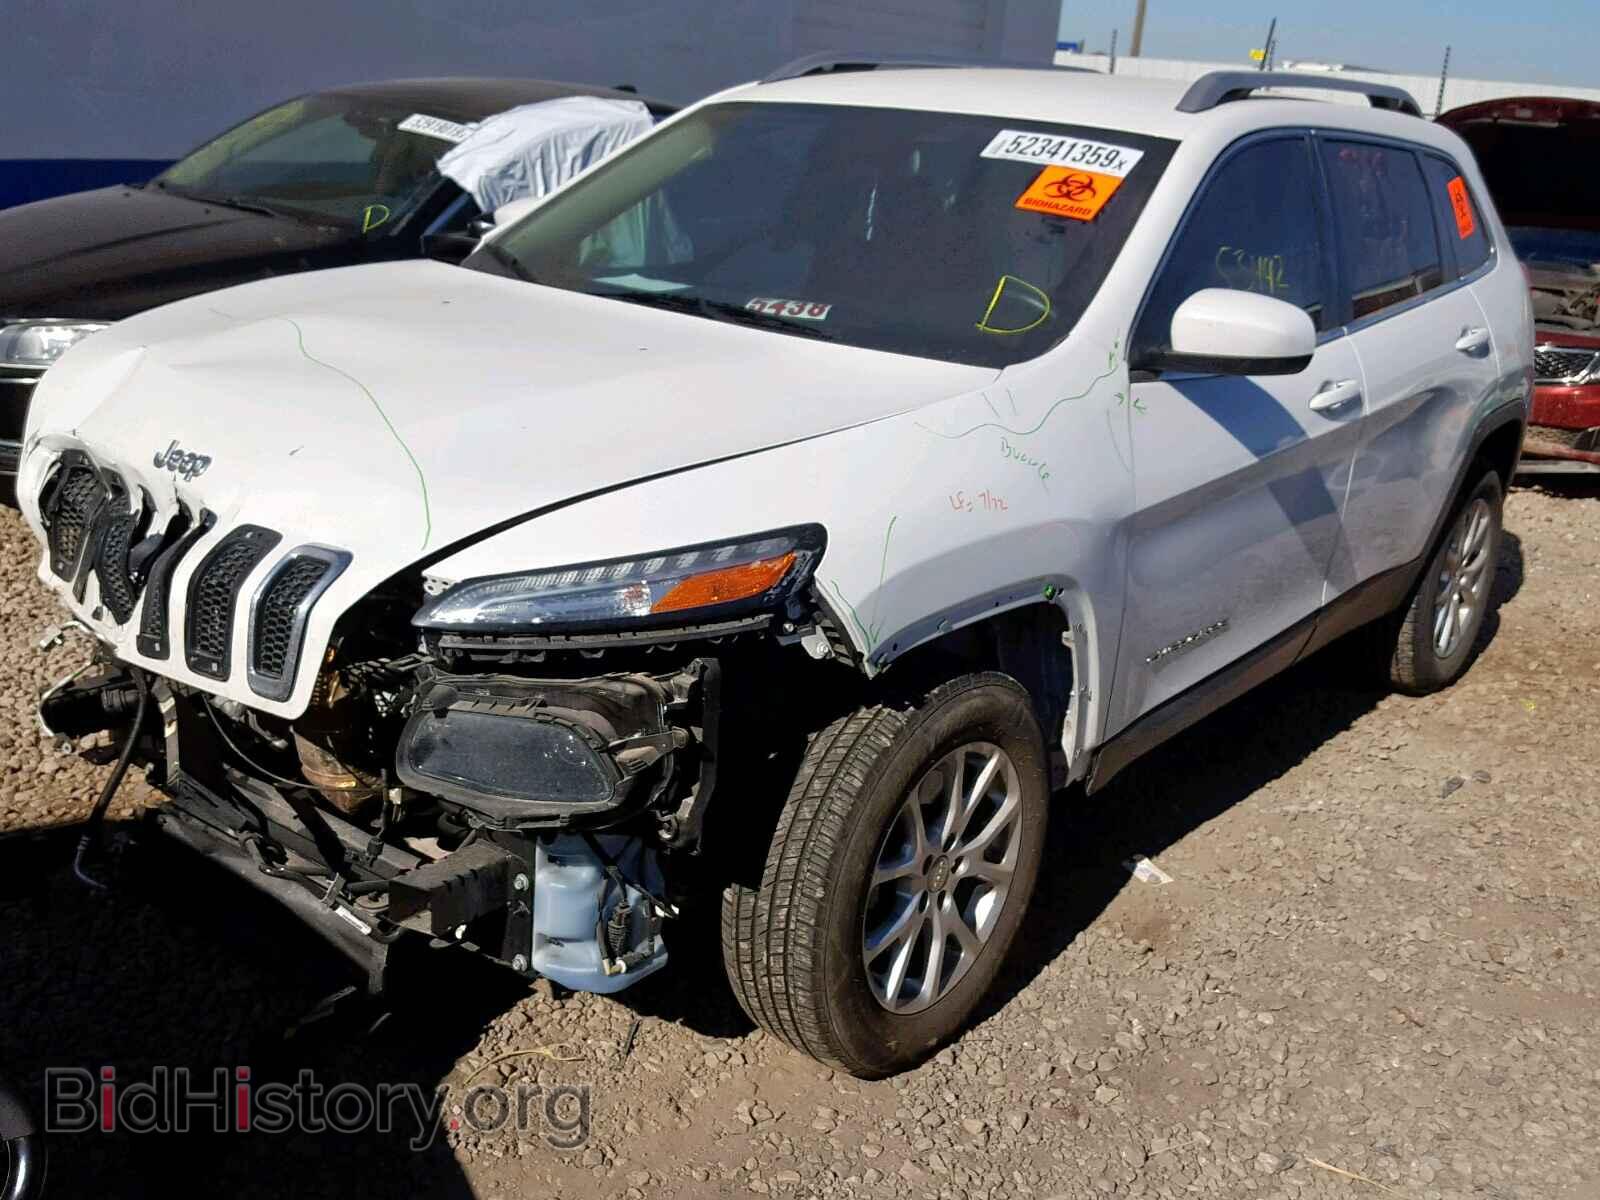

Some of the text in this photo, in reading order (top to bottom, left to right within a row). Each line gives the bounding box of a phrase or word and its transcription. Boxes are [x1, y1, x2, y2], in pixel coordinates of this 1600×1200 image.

[362, 204, 390, 234] D
[1023, 197, 1093, 216] BIOHAZARD
[975, 274, 1051, 335] D
[153, 439, 212, 482] Jeep
